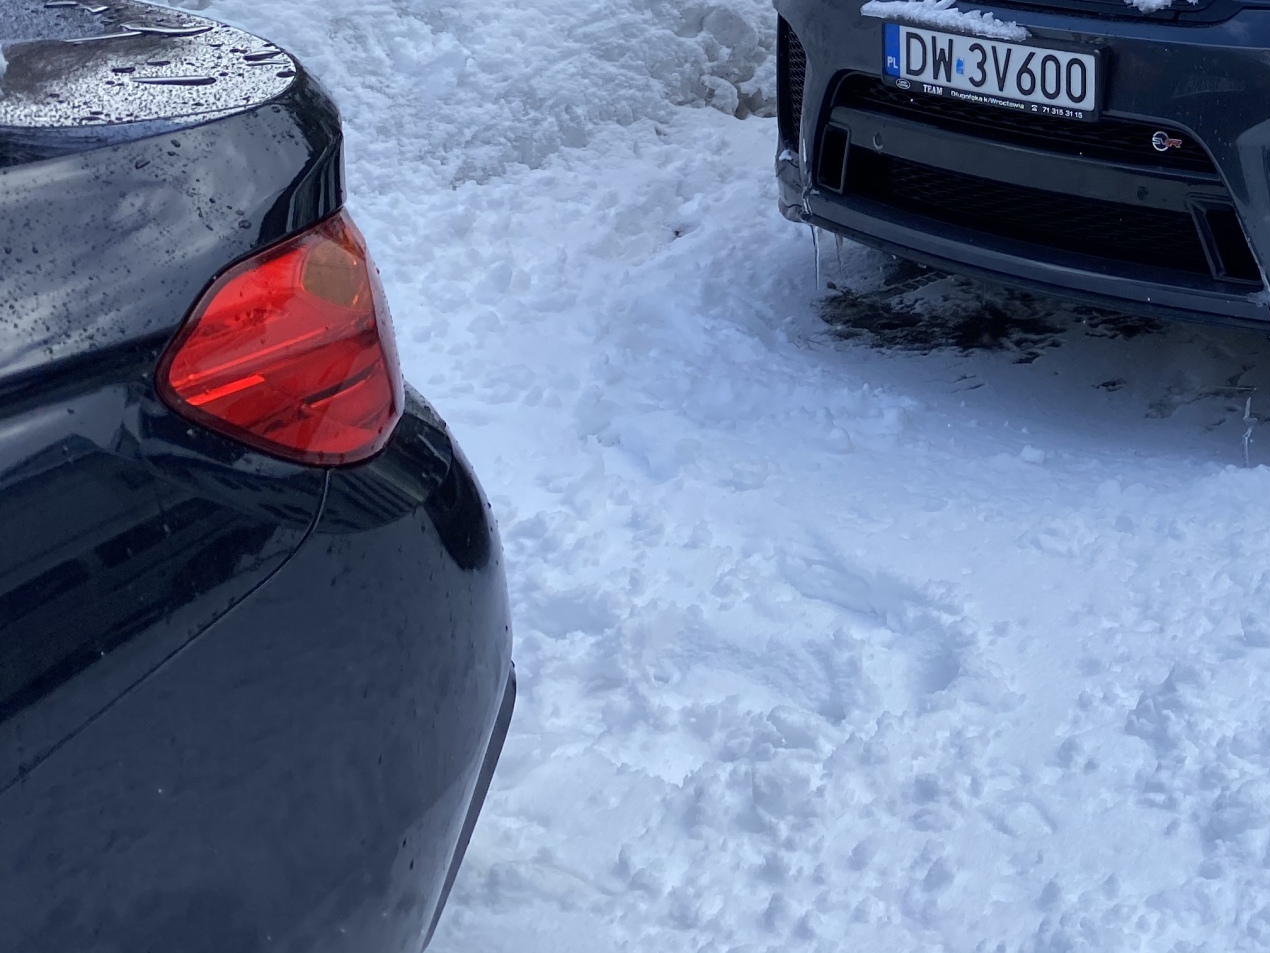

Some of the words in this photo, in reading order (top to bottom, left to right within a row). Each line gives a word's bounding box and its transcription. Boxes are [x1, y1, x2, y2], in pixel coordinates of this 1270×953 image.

[887, 56, 898, 69] PL
[905, 32, 953, 83] DW
[968, 42, 1087, 104] 3V600
[923, 84, 943, 96] TEAM
